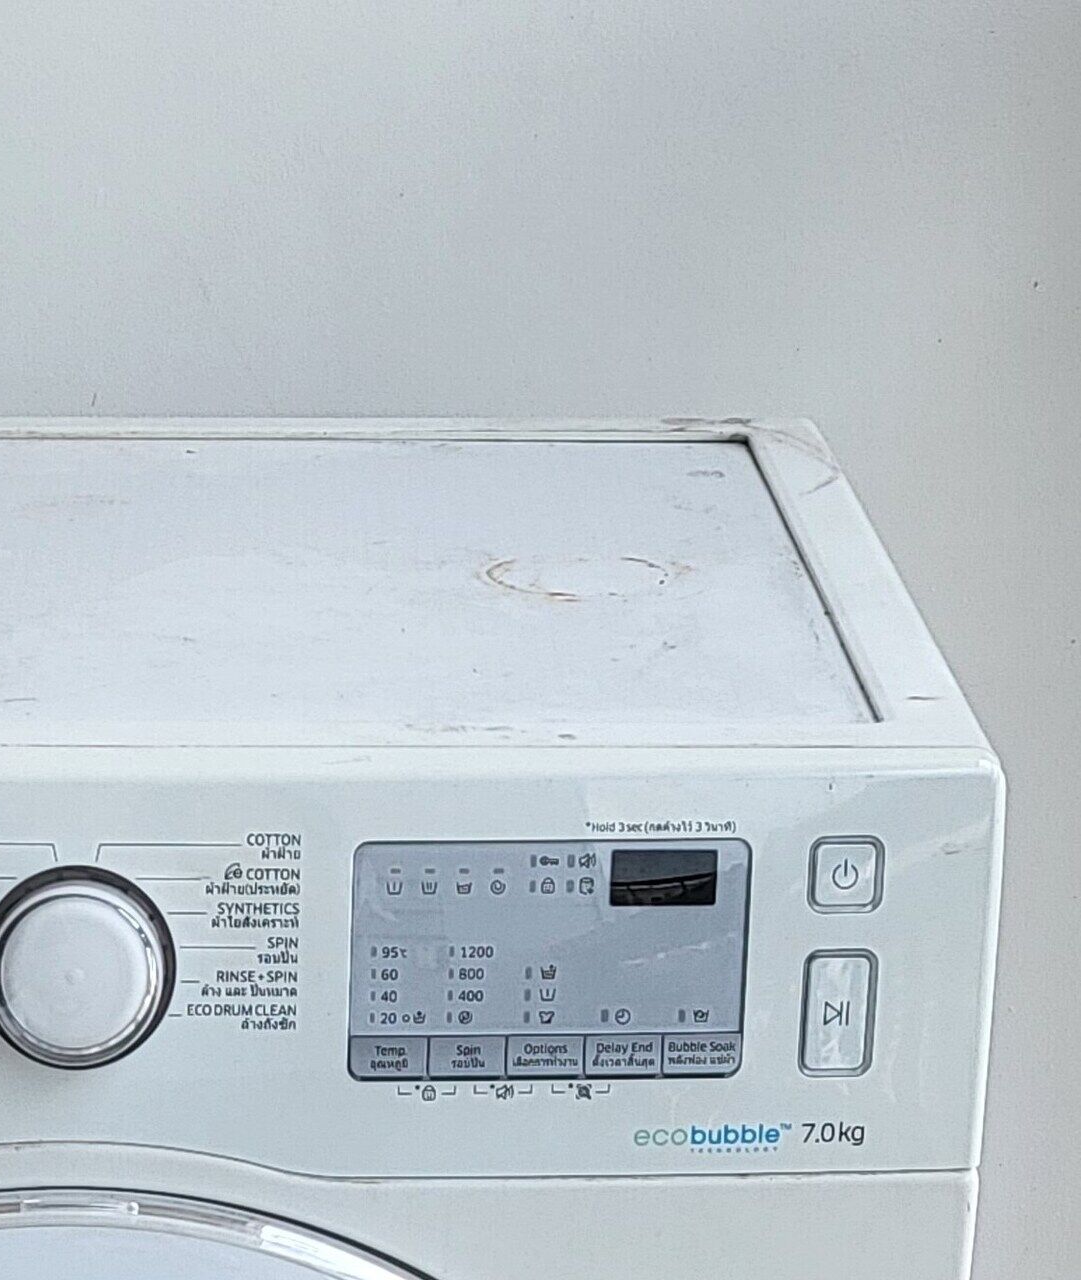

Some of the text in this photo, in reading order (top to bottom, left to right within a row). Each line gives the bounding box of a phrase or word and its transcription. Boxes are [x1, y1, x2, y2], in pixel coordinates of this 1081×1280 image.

[246, 833, 301, 846] COTTON
[246, 868, 301, 881] COTTON
[217, 902, 301, 916] SYNTHETICS
[267, 936, 299, 949] SPIN
[461, 946, 494, 959] 1200
[216, 970, 256, 983] RINSE
[266, 970, 298, 983] SPIN
[381, 968, 399, 981] 60
[459, 967, 485, 980] 800
[380, 990, 398, 1003] 40
[458, 989, 484, 1002] 400
[187, 1003, 297, 1017] ECO DRUM CLEAN
[380, 1012, 397, 1025] 20
[456, 1044, 481, 1058] Spin
[523, 1043, 569, 1057] Options
[595, 1041, 654, 1055] Delay End
[668, 1040, 736, 1053] Bubble Soak
